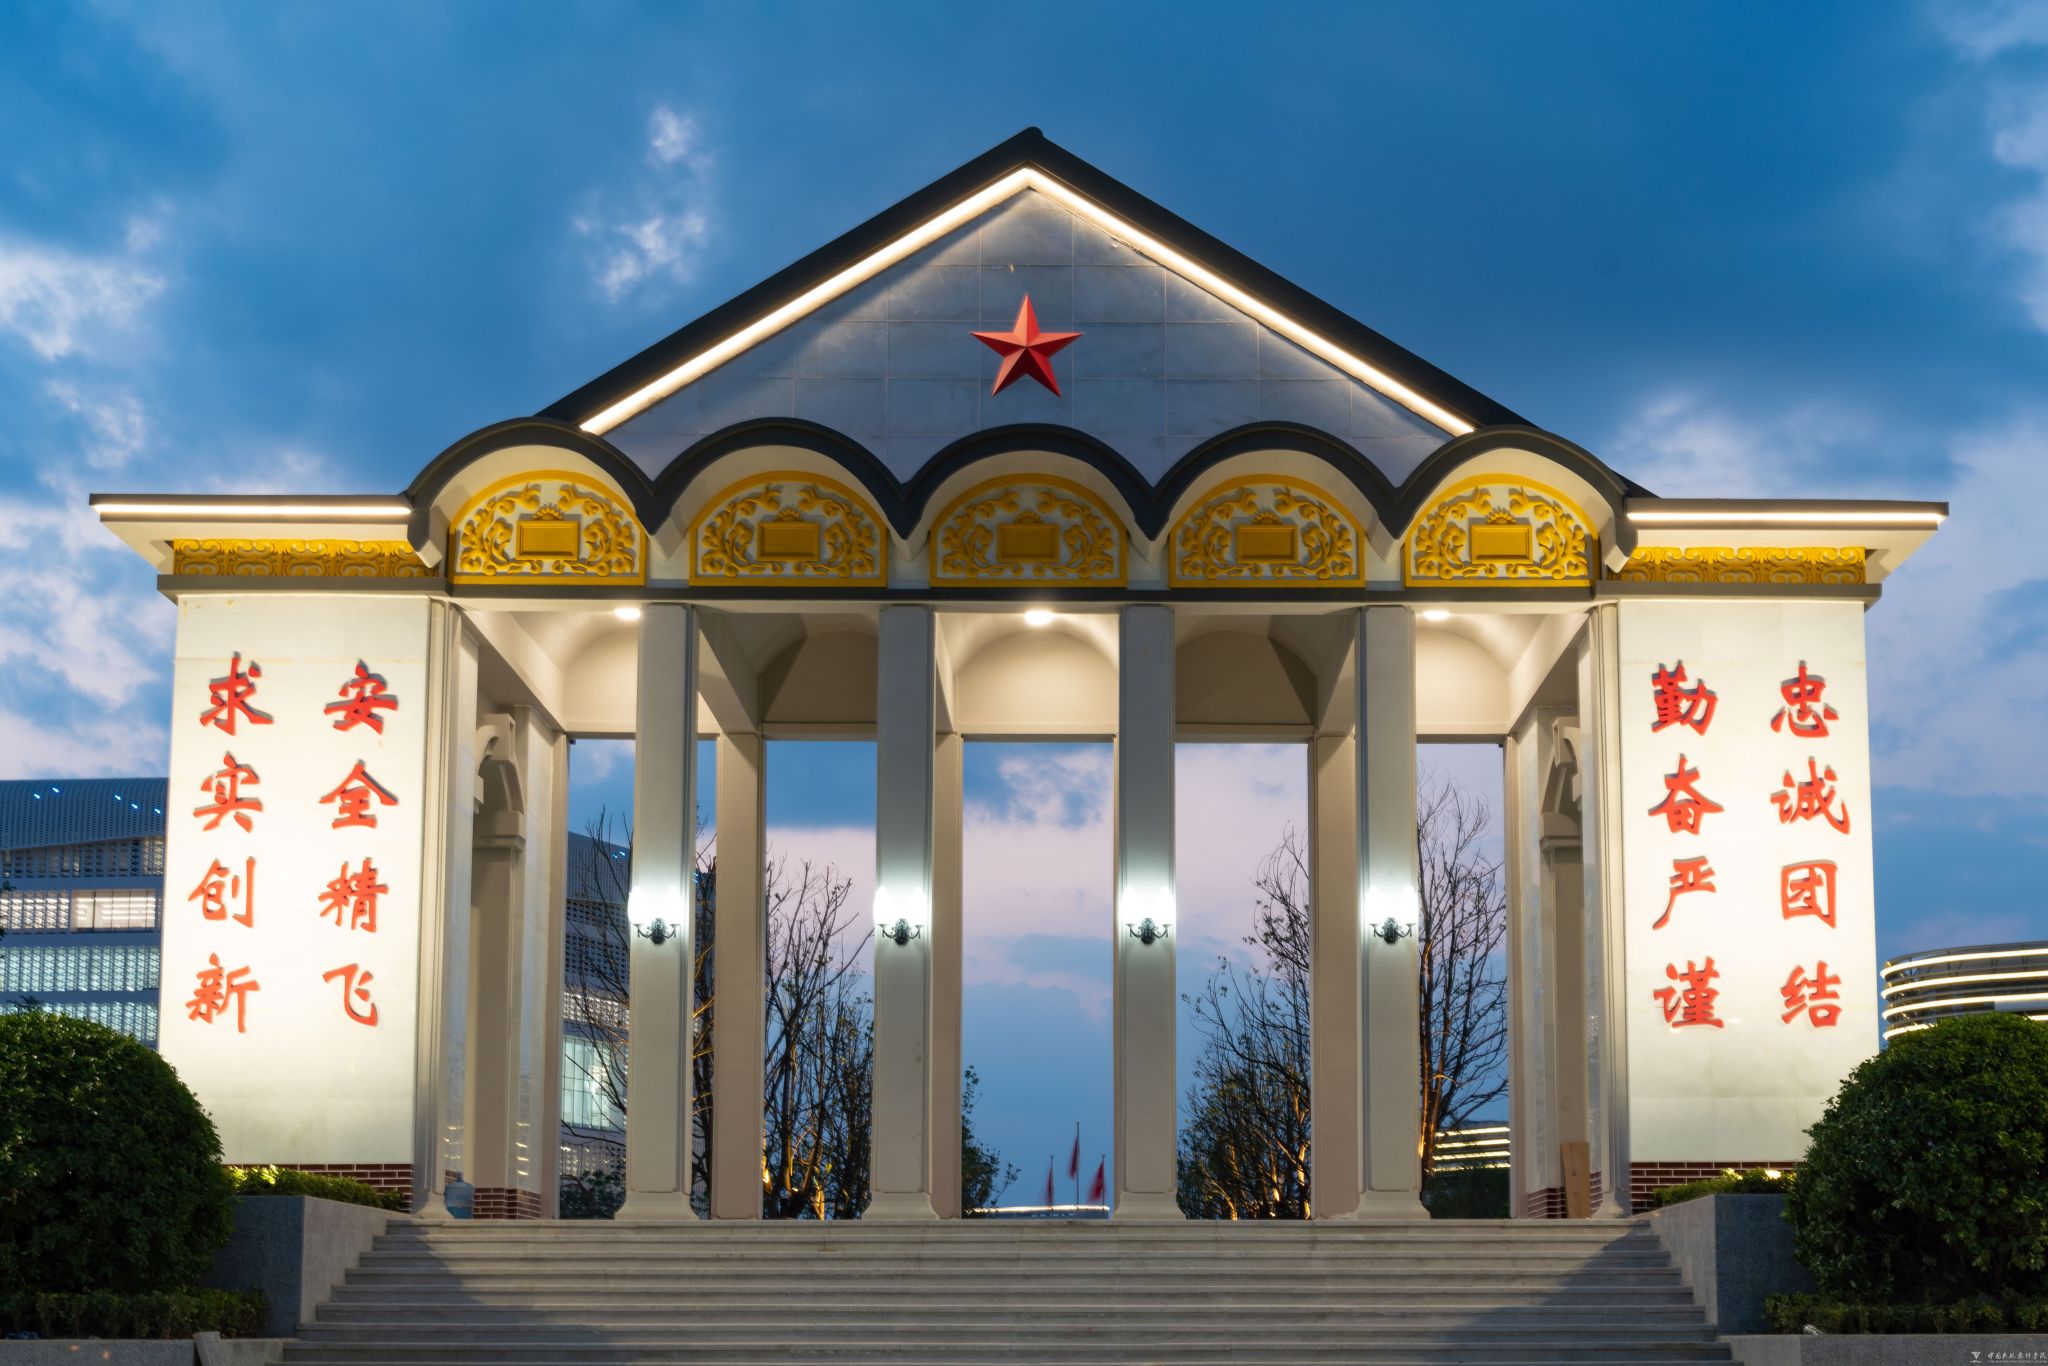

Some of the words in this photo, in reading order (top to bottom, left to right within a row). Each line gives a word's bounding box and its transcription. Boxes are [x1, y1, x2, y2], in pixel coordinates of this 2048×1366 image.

[187, 654, 273, 1033] 求实创新
[319, 661, 398, 1027] 安全精飞
[1648, 660, 1725, 1028] 勤奋严谨
[1769, 661, 1850, 1027] 忠诚团结
